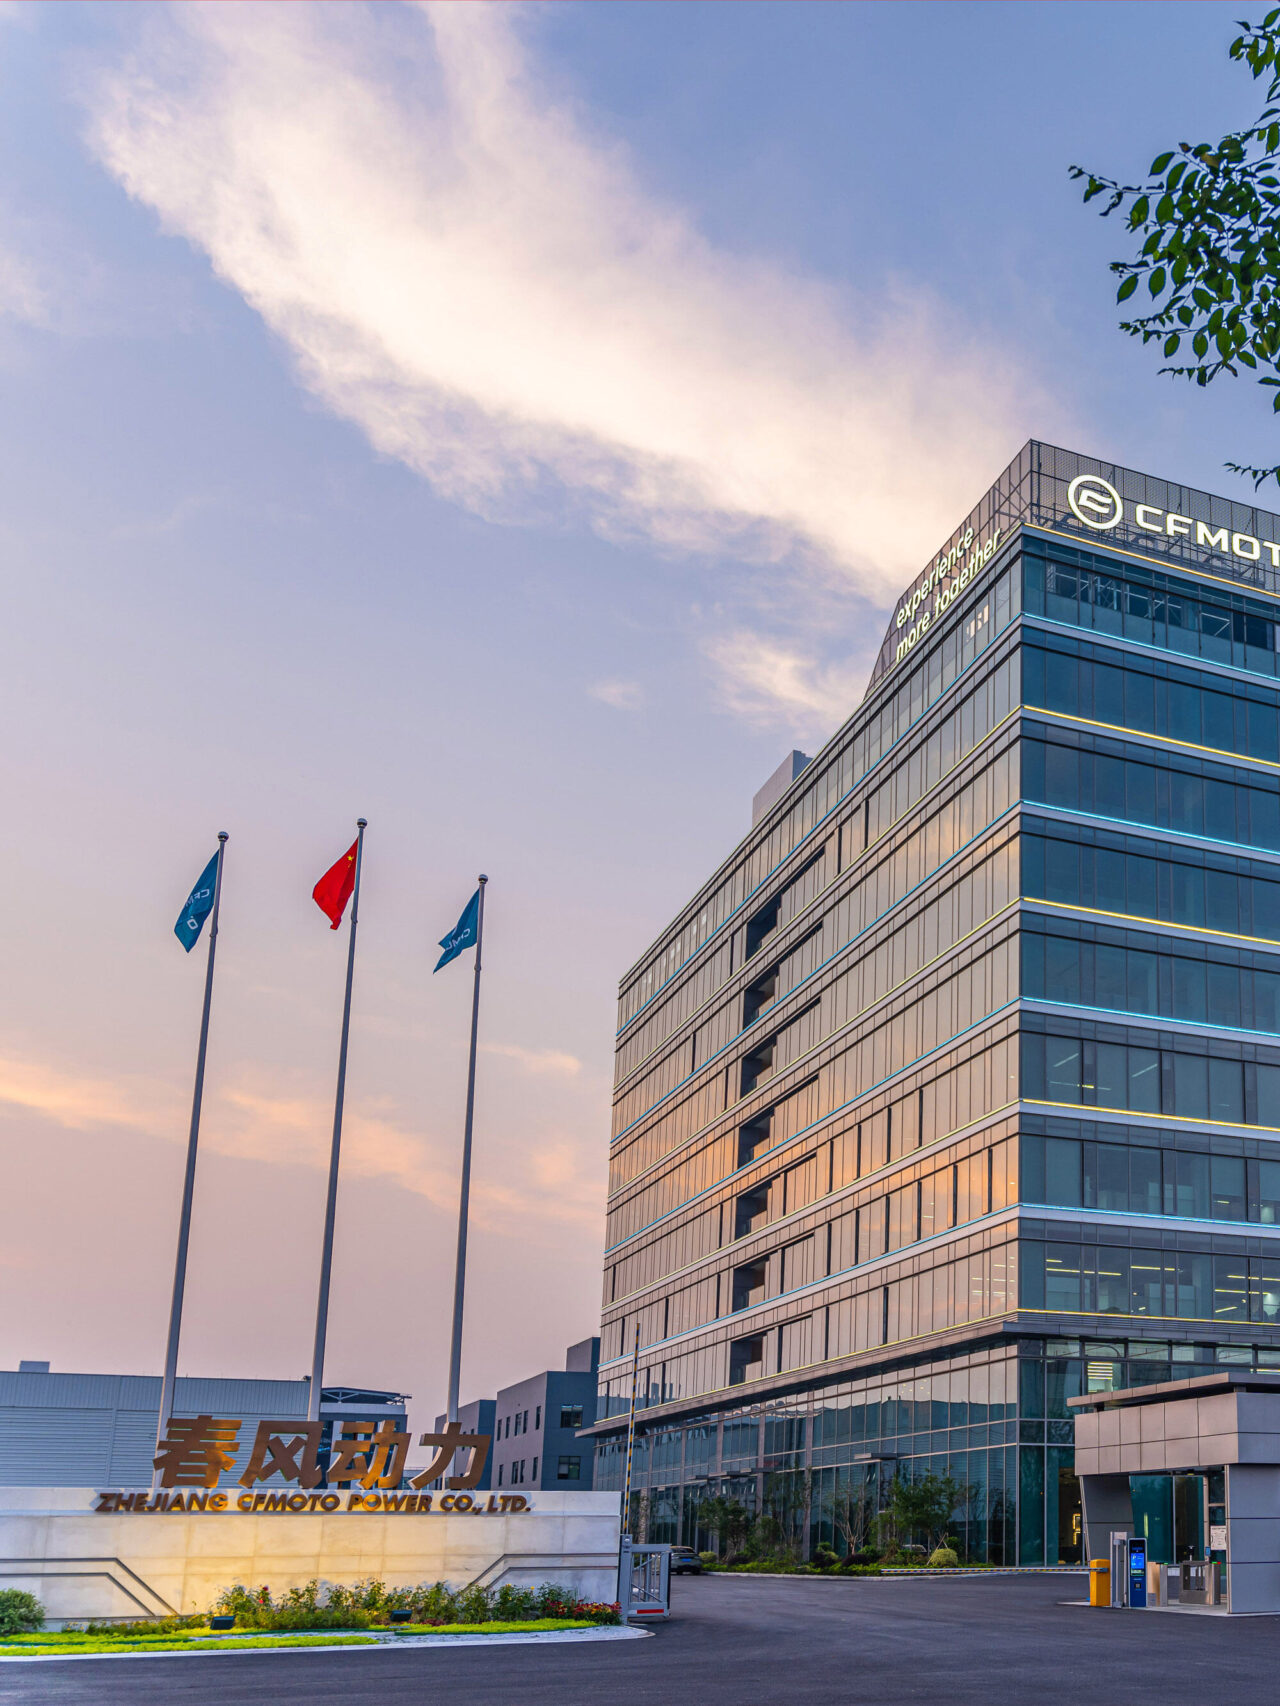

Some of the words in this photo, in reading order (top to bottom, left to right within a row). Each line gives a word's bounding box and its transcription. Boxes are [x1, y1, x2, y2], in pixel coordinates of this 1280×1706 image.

[896, 527, 974, 629] experience
[896, 610, 931, 663] more
[152, 1415, 492, 1490] 春风动力
[95, 1492, 229, 1513] ZHEJIANG
[237, 1492, 341, 1513] CFMOTO
[346, 1493, 434, 1513] POWER
